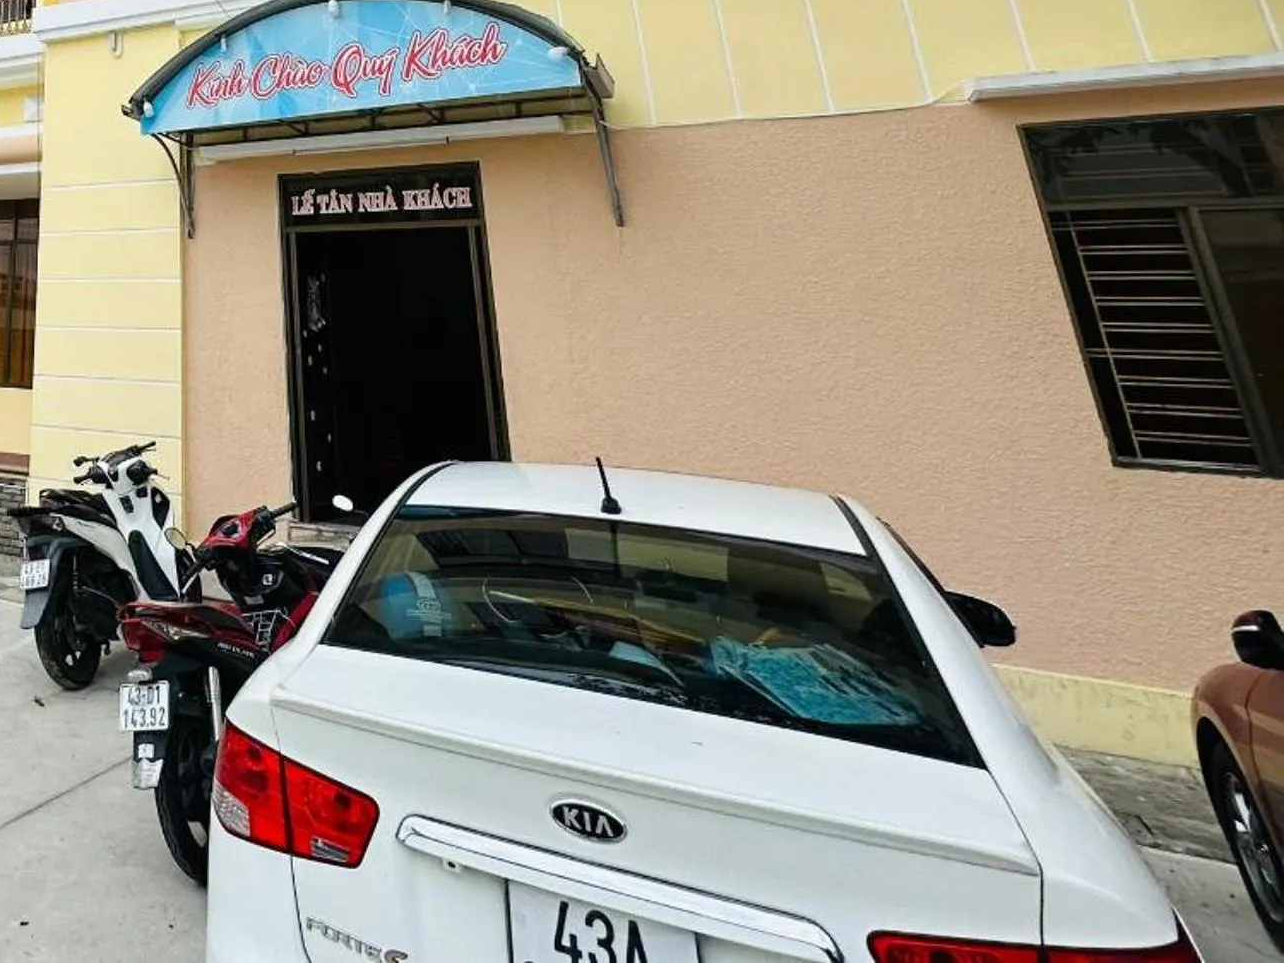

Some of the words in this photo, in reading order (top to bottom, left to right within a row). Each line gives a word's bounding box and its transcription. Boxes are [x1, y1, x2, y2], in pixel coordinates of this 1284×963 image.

[251, 52, 328, 101] Chào
[330, 40, 399, 99] Quý
[400, 20, 507, 82] Khách
[316, 188, 353, 215] TÂN
[357, 184, 398, 212] NHÀ
[402, 182, 474, 211] KHÁCH
[562, 805, 614, 838] KIA
